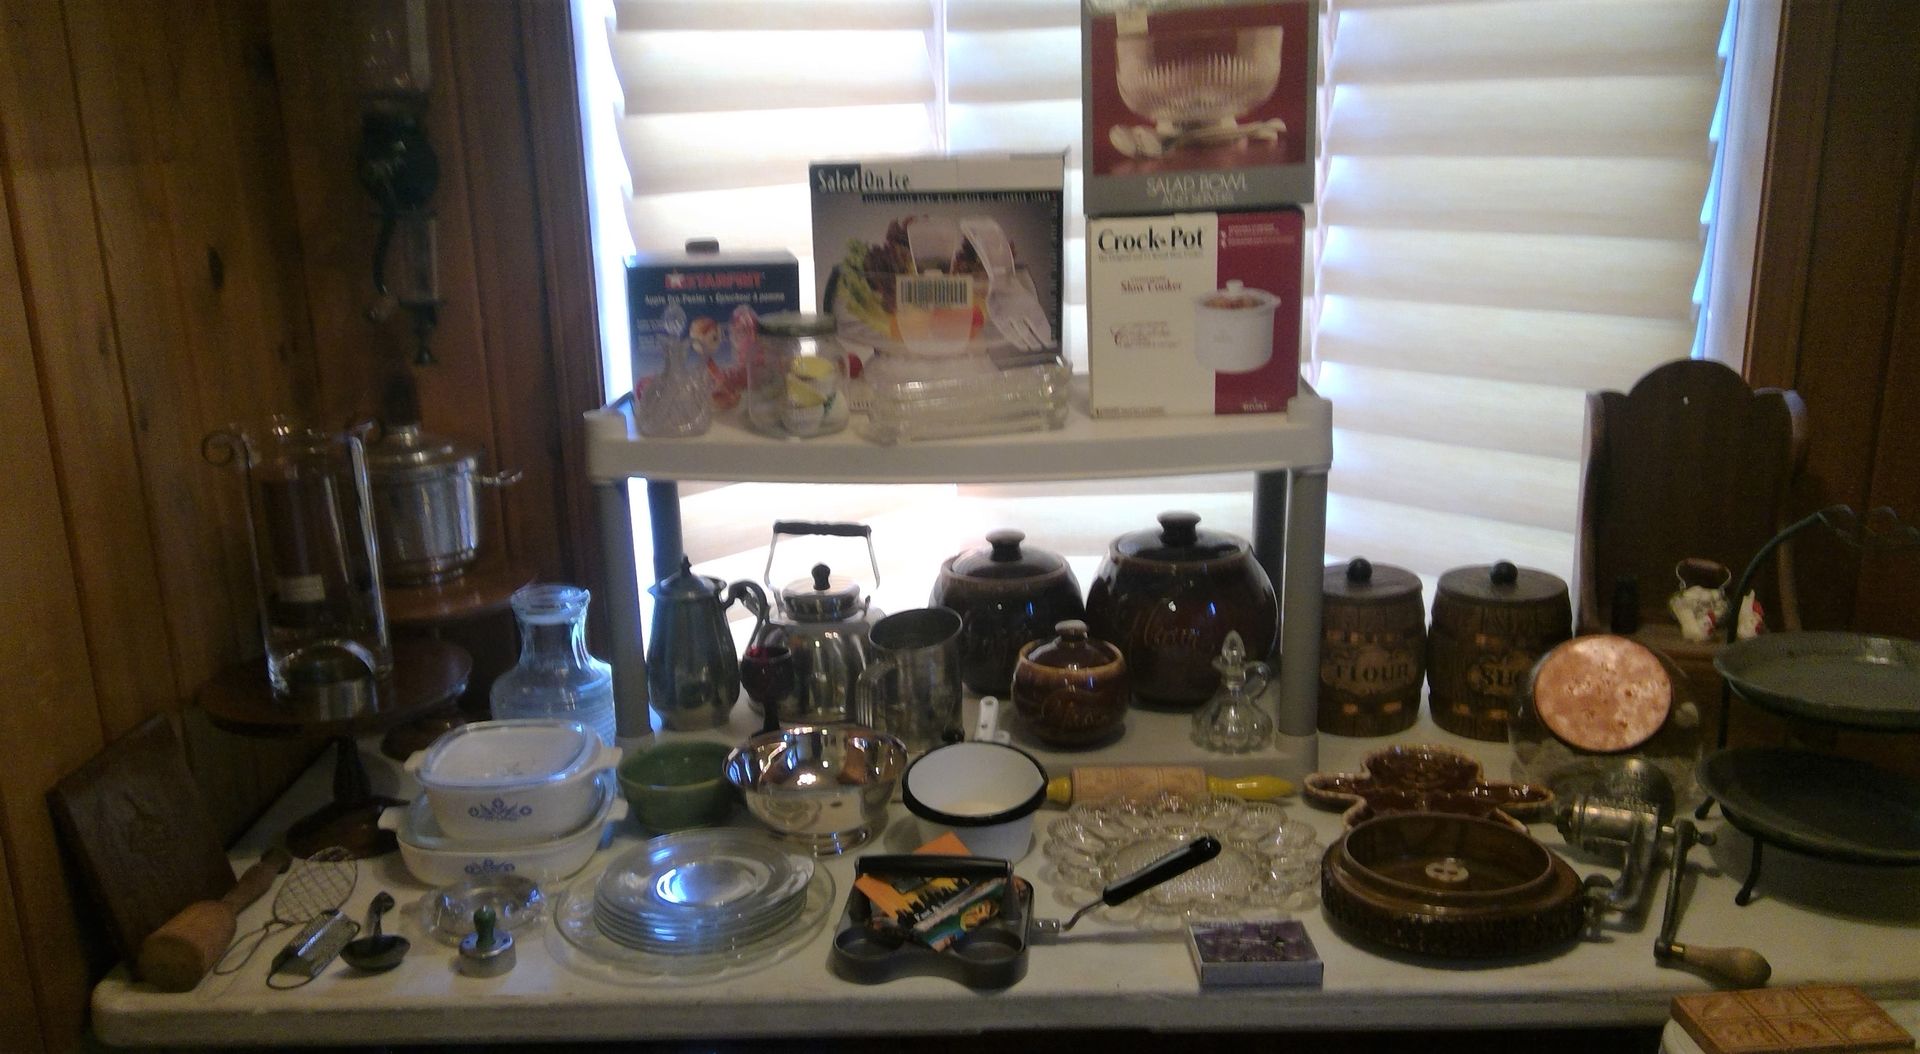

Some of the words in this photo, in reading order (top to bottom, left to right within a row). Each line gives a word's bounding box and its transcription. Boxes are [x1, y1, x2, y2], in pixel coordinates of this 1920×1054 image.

[818, 168, 861, 192] Salad
[864, 167, 884, 191] On
[888, 168, 910, 191] Ice
[1146, 174, 1195, 195] SALAD
[1199, 171, 1247, 192] BOWL
[1336, 662, 1409, 682] FLOUR
